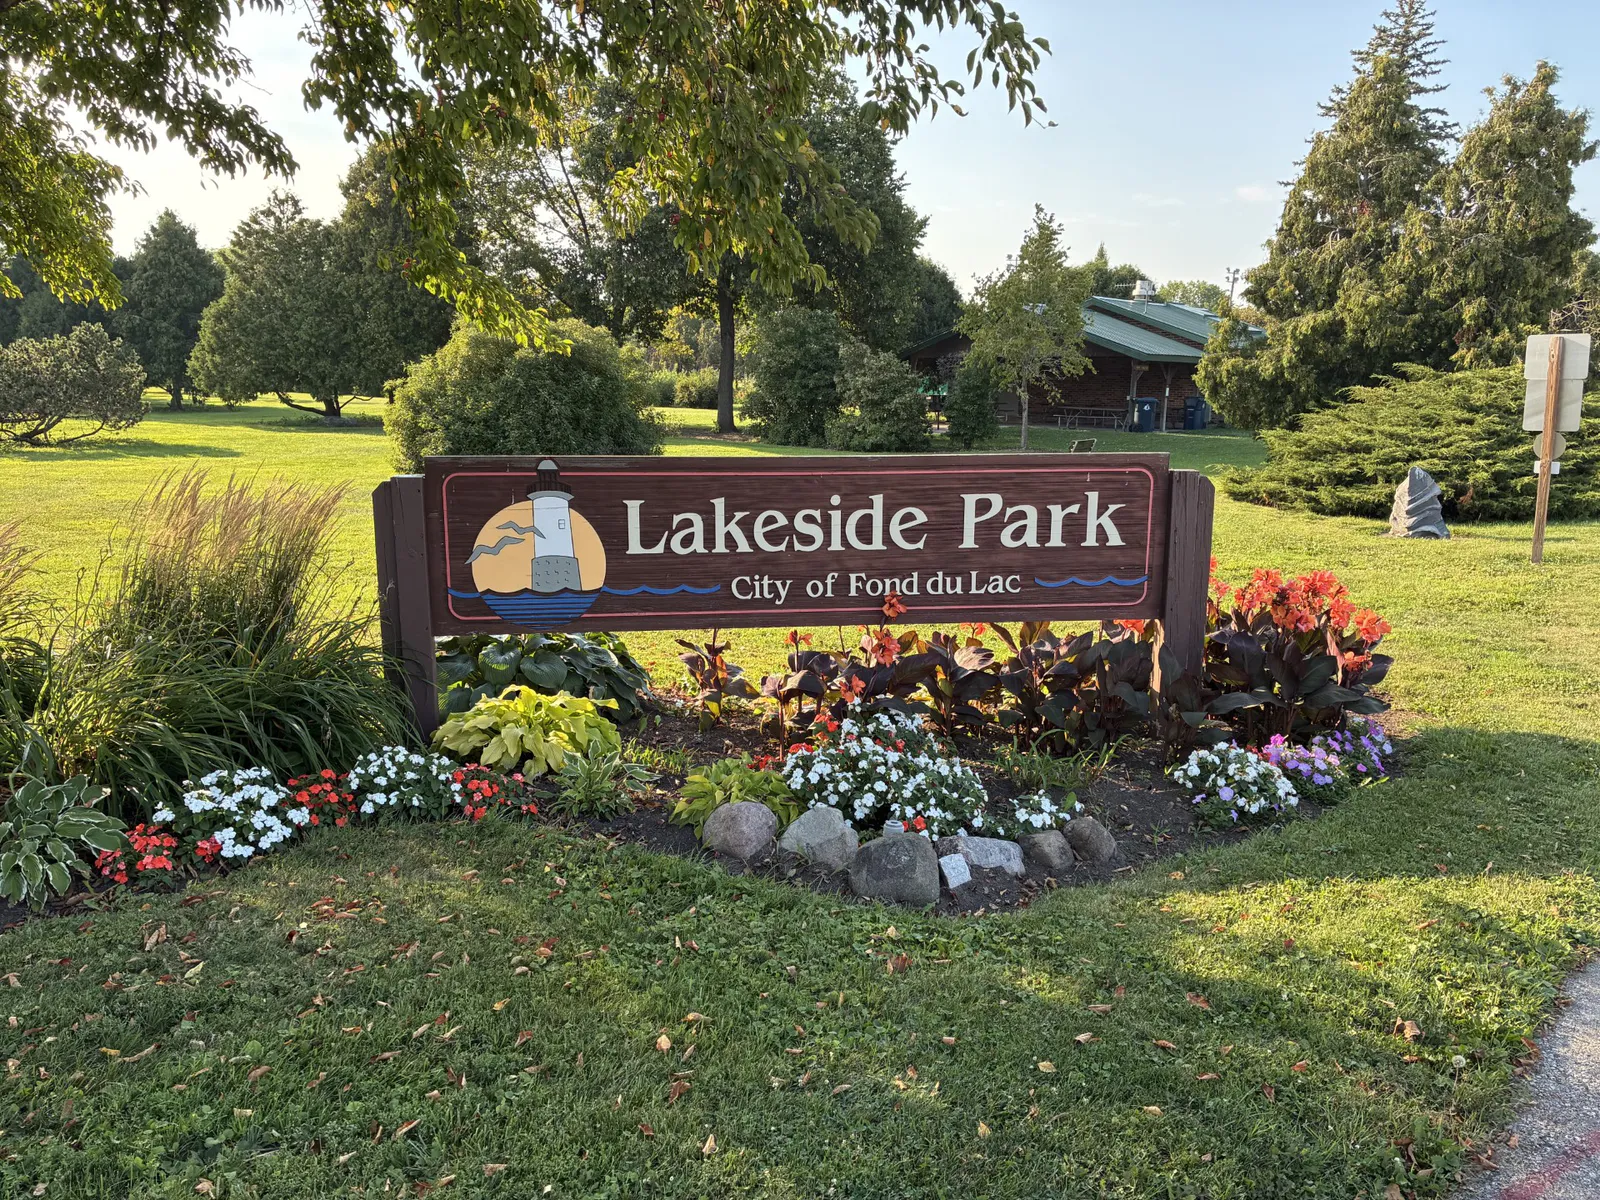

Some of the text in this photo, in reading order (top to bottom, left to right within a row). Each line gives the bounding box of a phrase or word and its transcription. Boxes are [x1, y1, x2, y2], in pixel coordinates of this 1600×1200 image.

[622, 490, 1126, 556] Lakeside Park
[730, 570, 1021, 605] City of Fond du Lac
